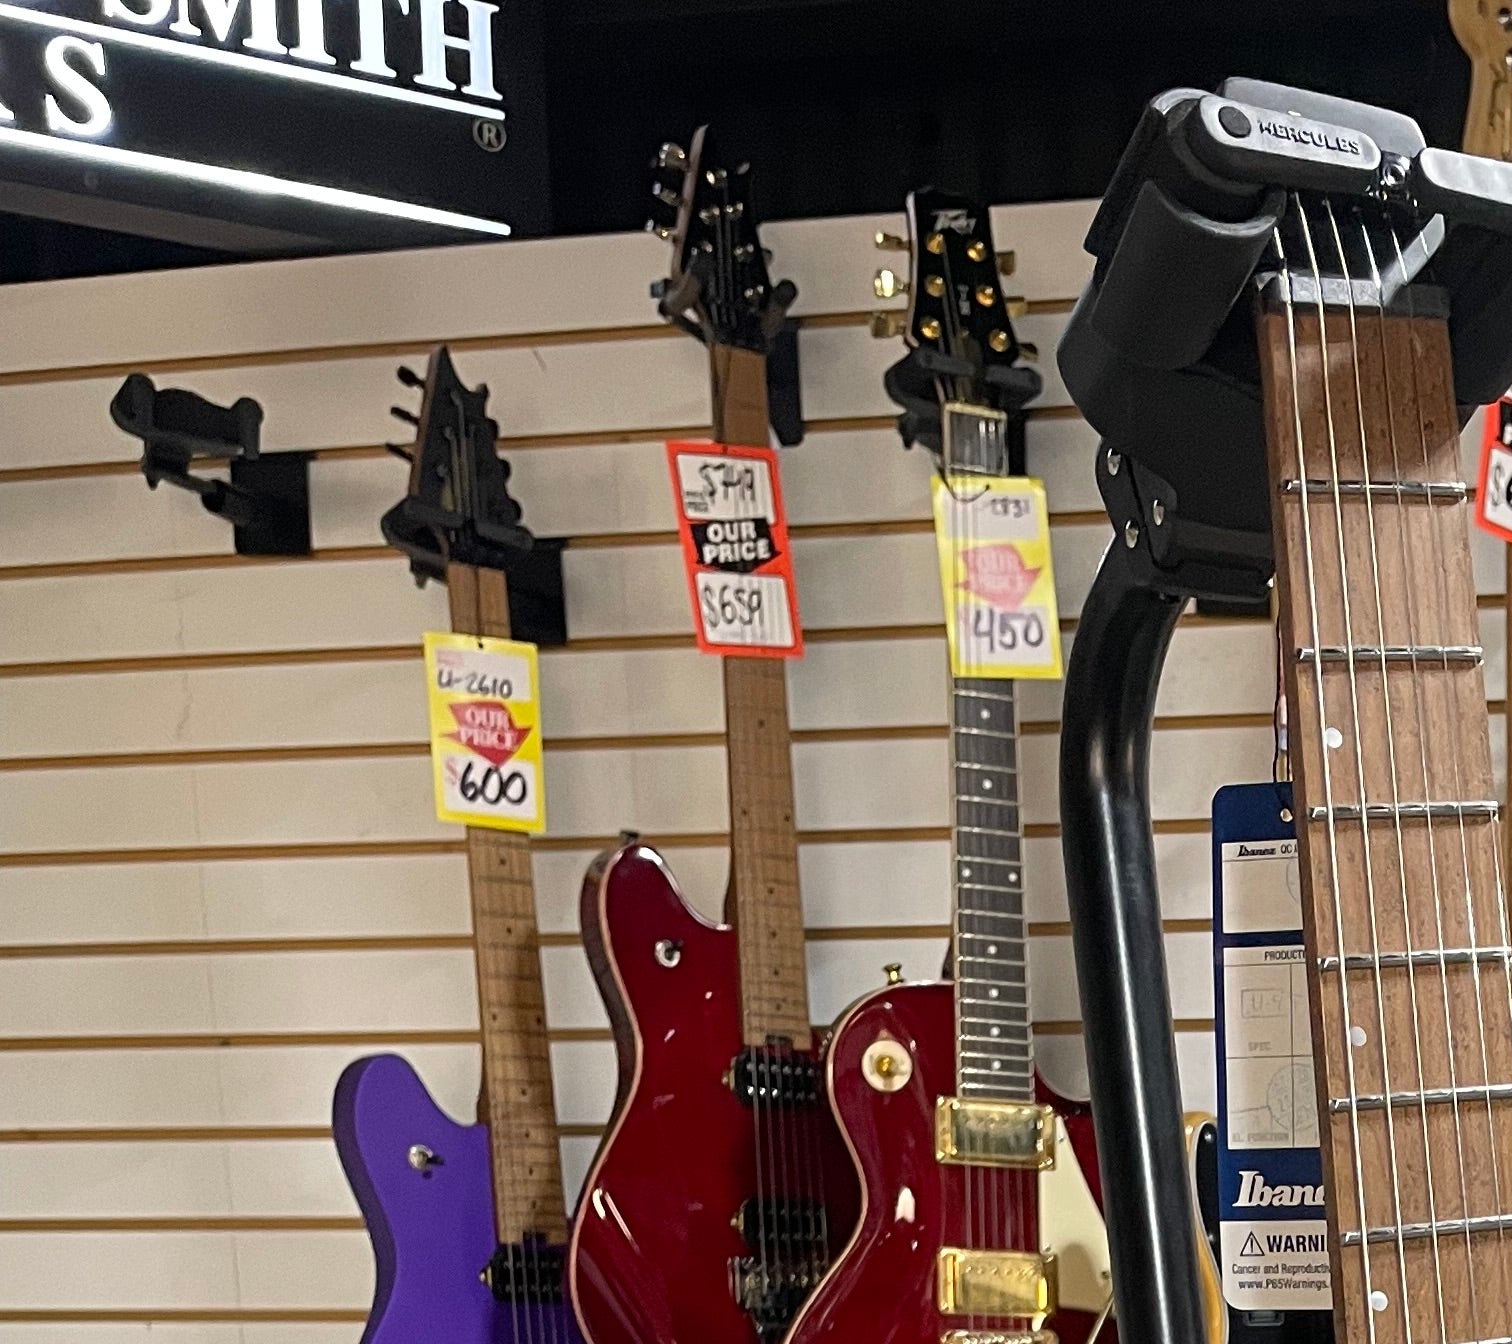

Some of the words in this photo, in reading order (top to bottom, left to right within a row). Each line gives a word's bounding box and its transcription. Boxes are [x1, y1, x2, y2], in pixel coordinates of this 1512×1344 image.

[103, 0, 503, 100] ITH
[1257, 118, 1361, 155] HERCULES
[706, 521, 757, 543] OUR
[702, 539, 771, 564] PRICE
[464, 704, 511, 732] OUR
[459, 727, 518, 751] PRICE
[1237, 844, 1276, 859] Ibanez
[1232, 1263, 1261, 1276] Cancer
[1263, 1263, 1280, 1275] and
